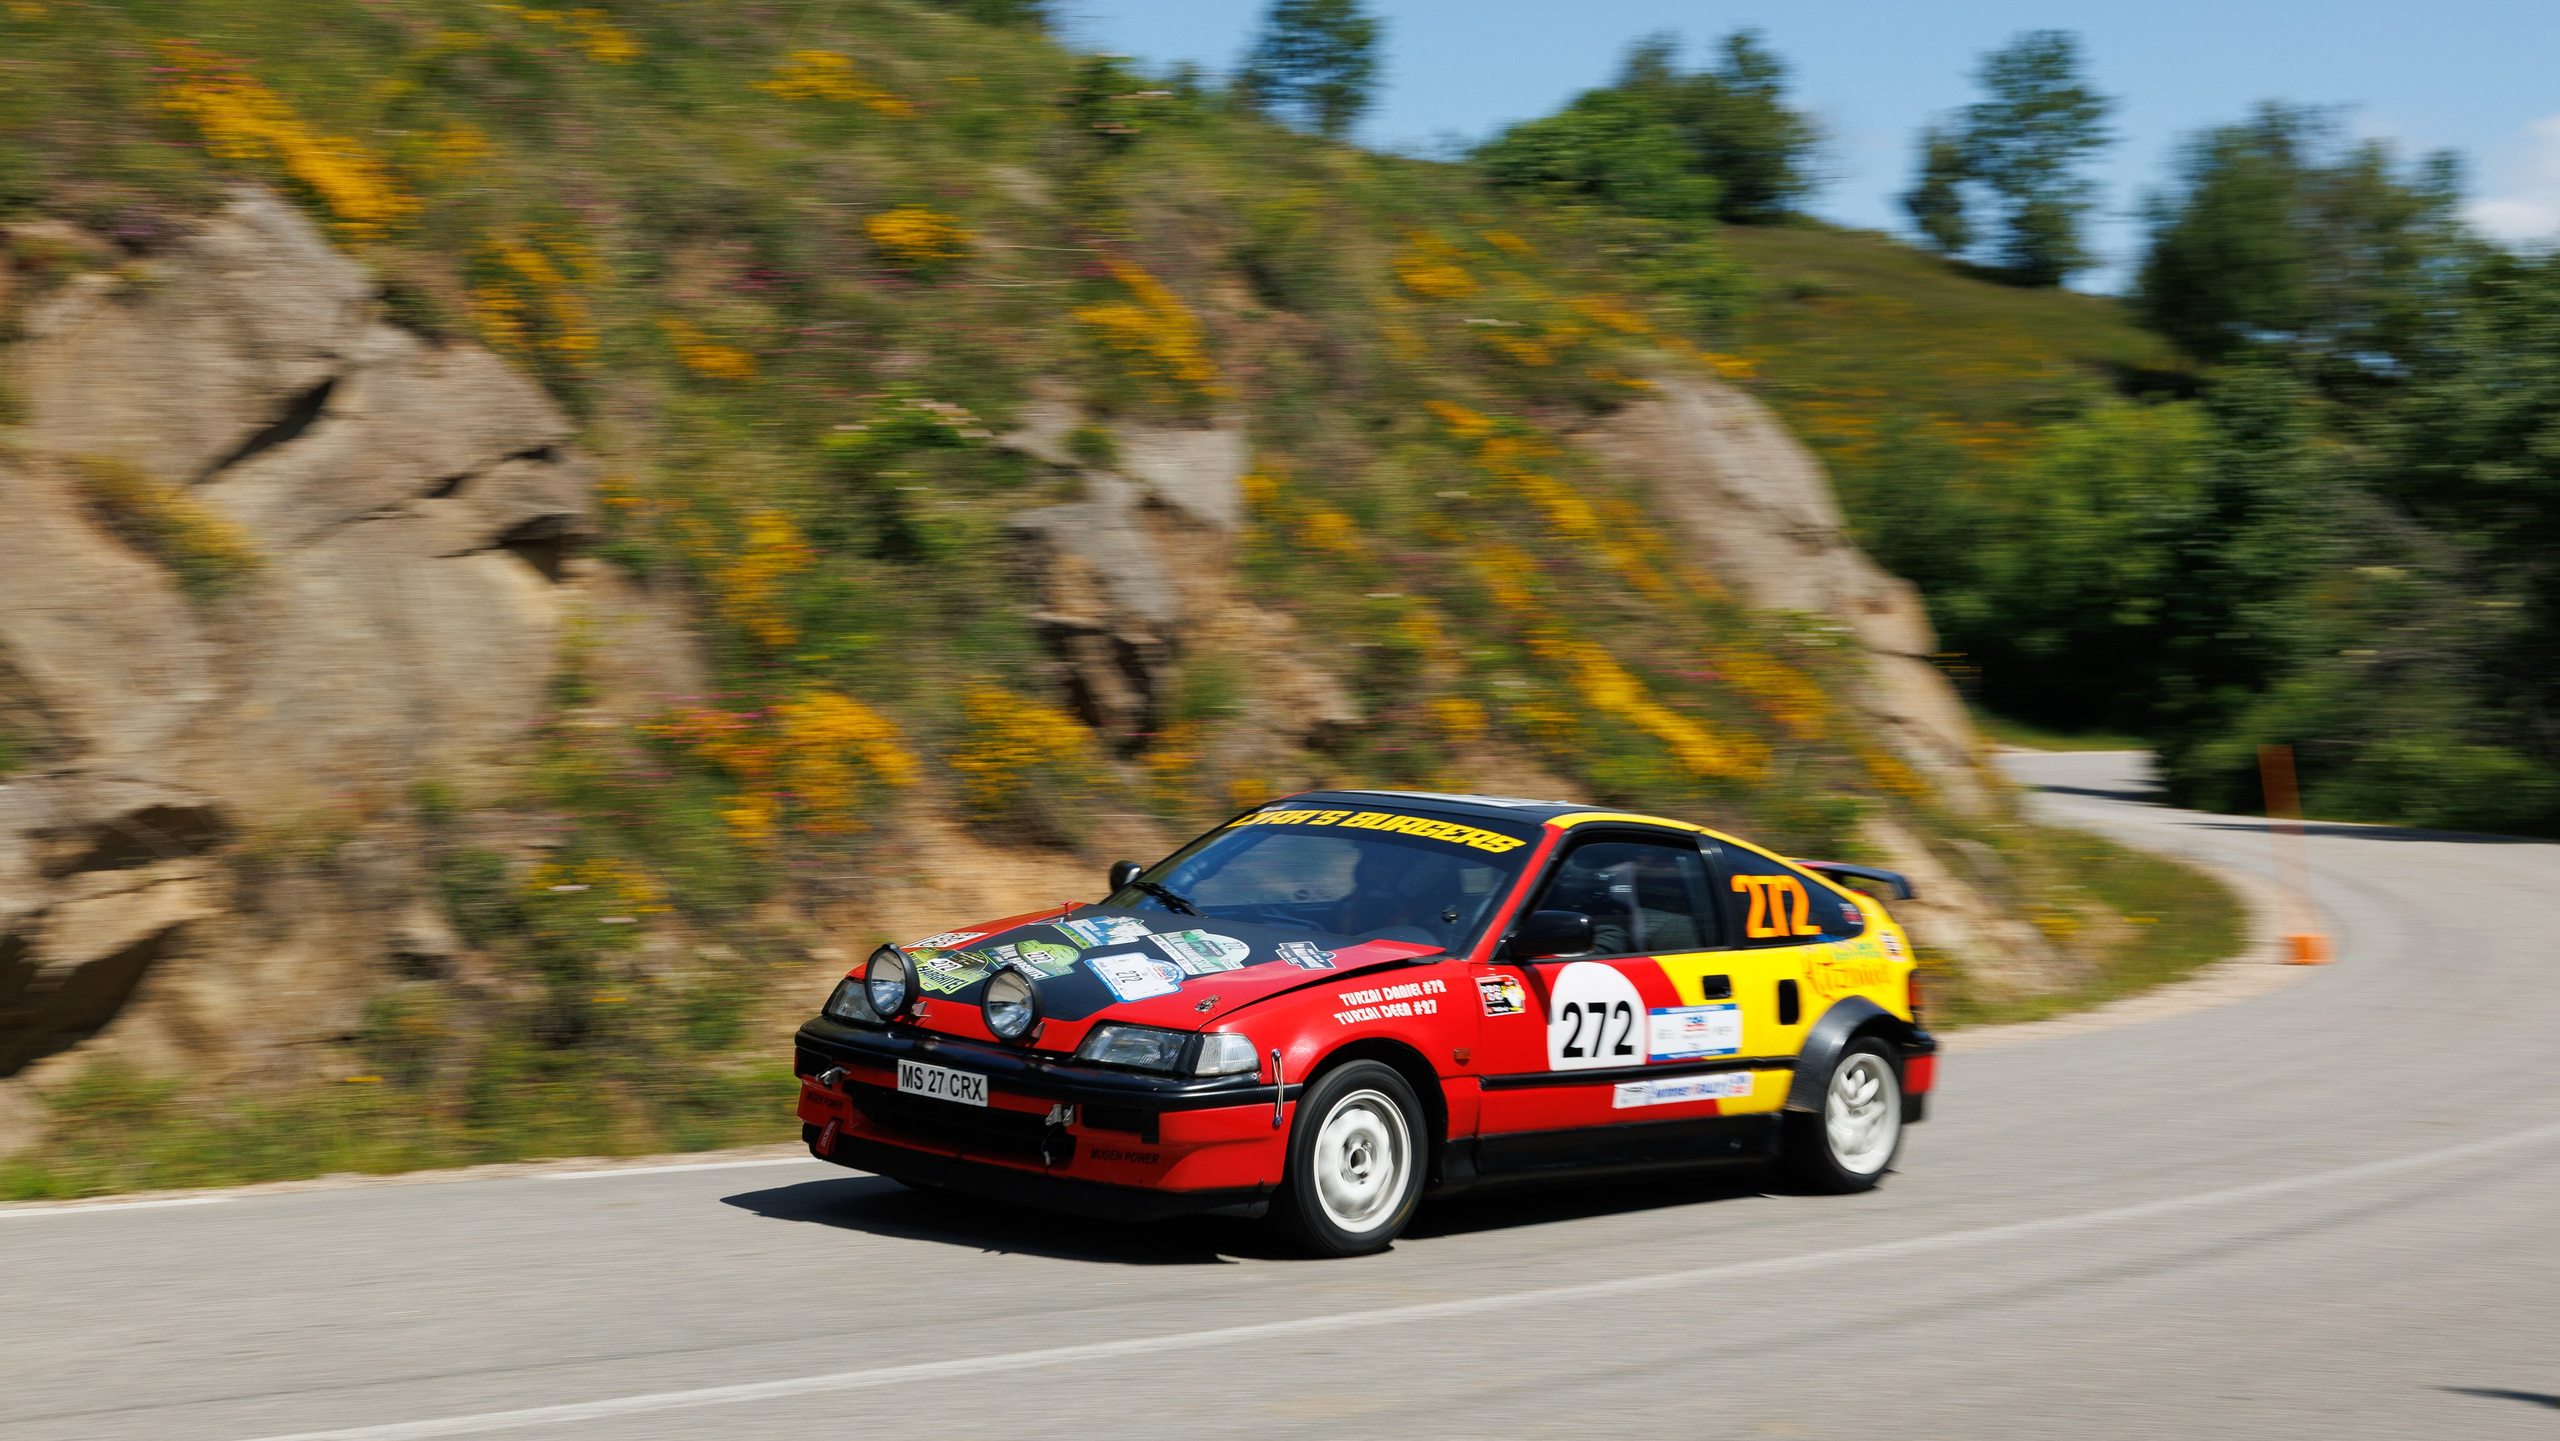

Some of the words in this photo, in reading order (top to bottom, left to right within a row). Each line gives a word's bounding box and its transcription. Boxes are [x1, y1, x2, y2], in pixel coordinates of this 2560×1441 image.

[1336, 811, 1527, 853] BURGERS
[1730, 874, 1822, 938] 272
[1338, 988, 1383, 1006] TURZAI
[1382, 982, 1423, 1001] DANIEL
[1422, 979, 1447, 995] #72
[1333, 1006, 1382, 1025] TURZAI
[1413, 999, 1437, 1015] #27
[1562, 1000, 1634, 1058] 272
[902, 1064, 924, 1090] MS
[928, 1069, 944, 1094] 27
[950, 1073, 983, 1102] CRX
[1124, 1151, 1160, 1165] POWER
